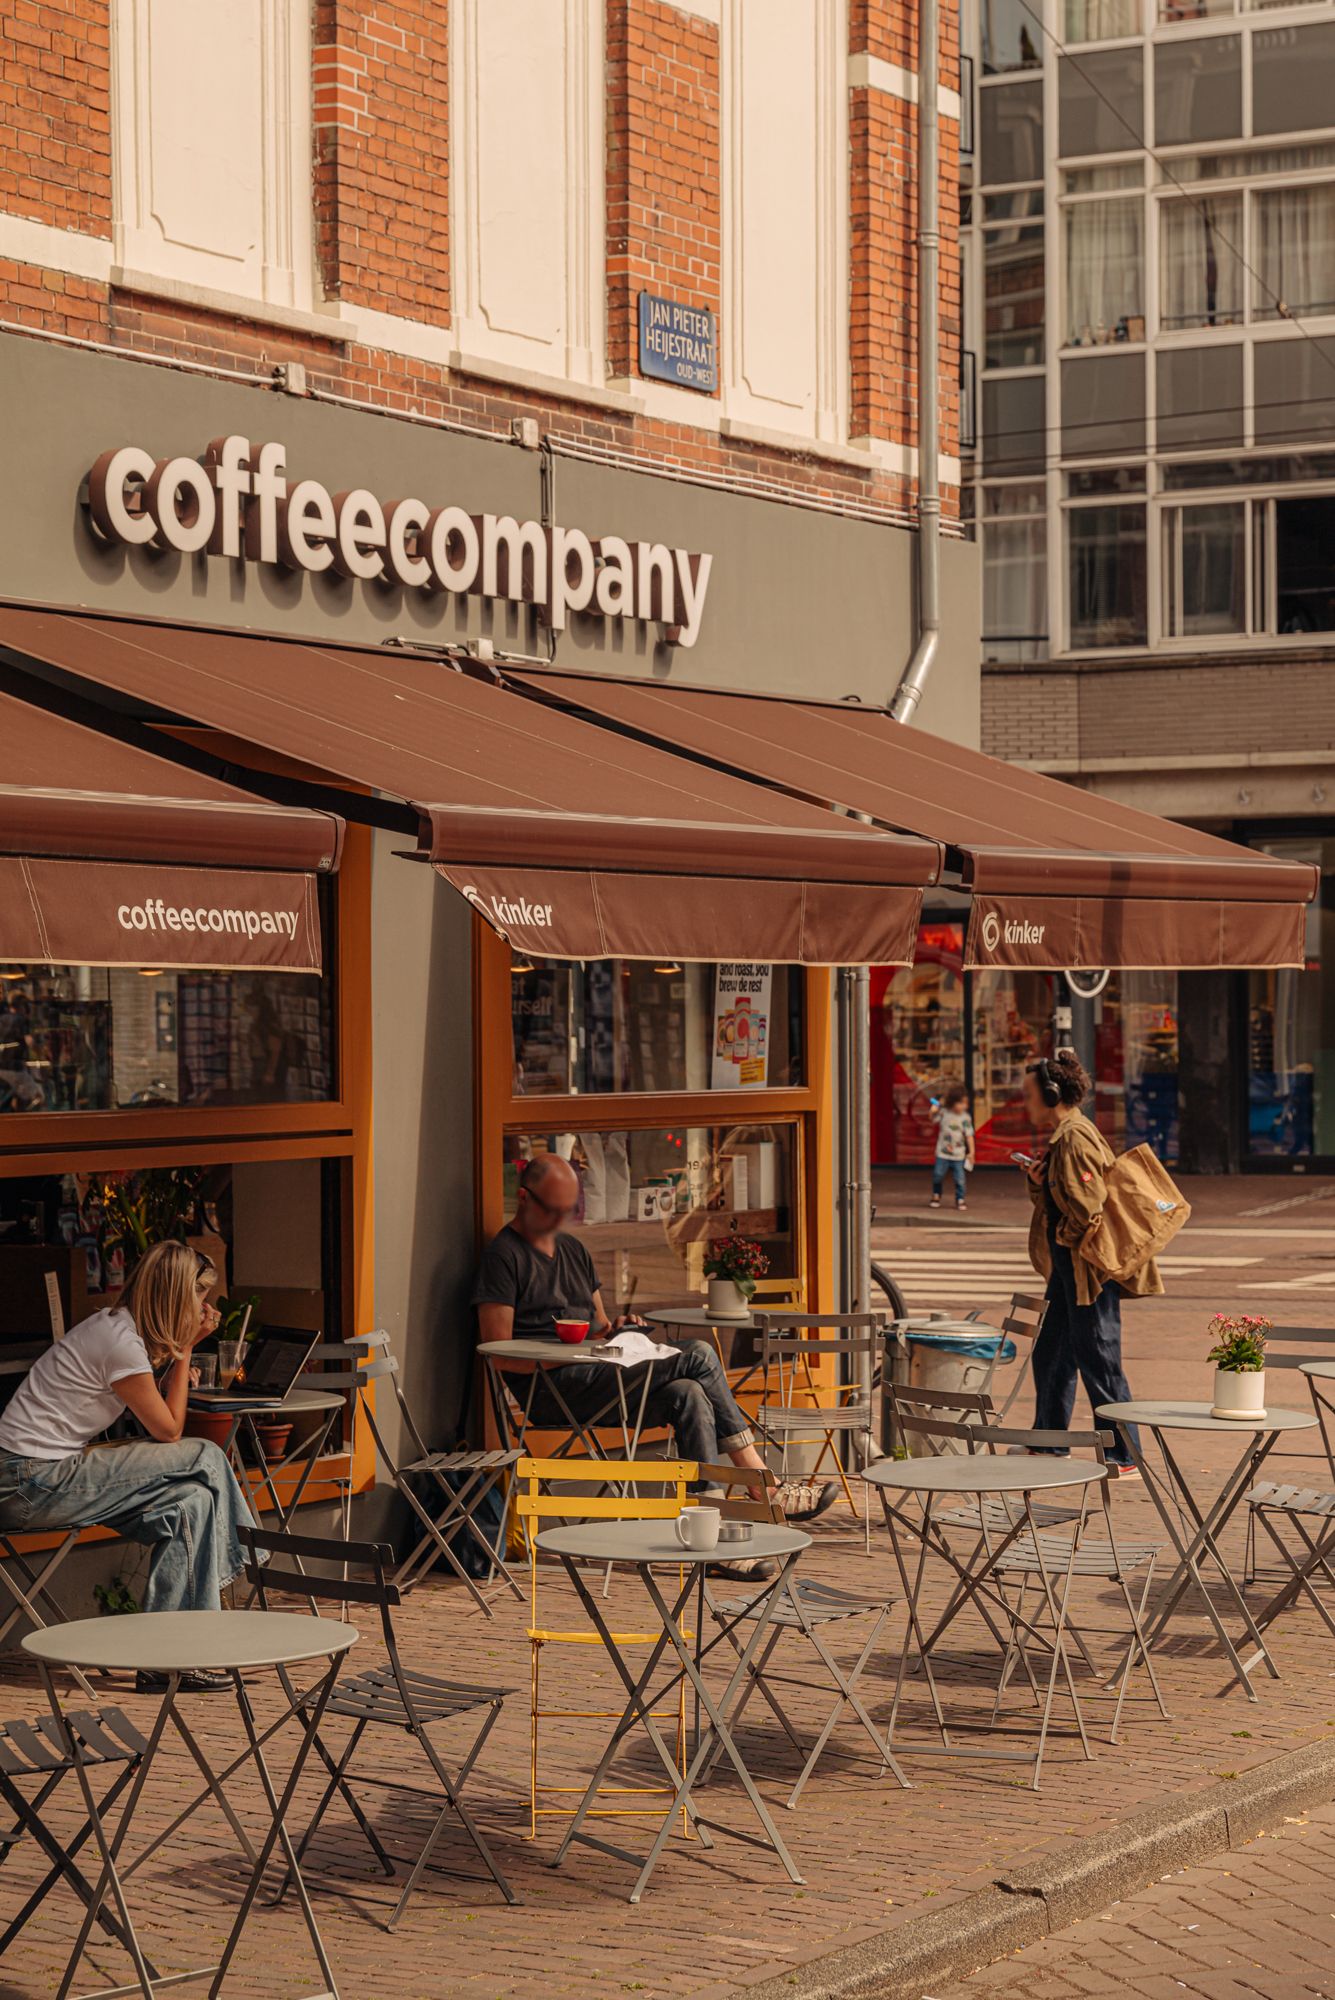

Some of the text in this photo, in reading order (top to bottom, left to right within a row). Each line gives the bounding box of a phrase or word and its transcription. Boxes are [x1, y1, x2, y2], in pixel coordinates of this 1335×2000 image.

[650, 301, 710, 339] JAN PIETER
[645, 326, 713, 366] HEIJESTRAAT
[676, 362, 713, 385] OUD-WEST
[103, 435, 713, 648] coffeecompany
[117, 898, 300, 941] coffeecompany
[490, 895, 553, 927] kinker
[1004, 919, 1046, 945] kinker
[719, 979, 763, 992] brew de rest
